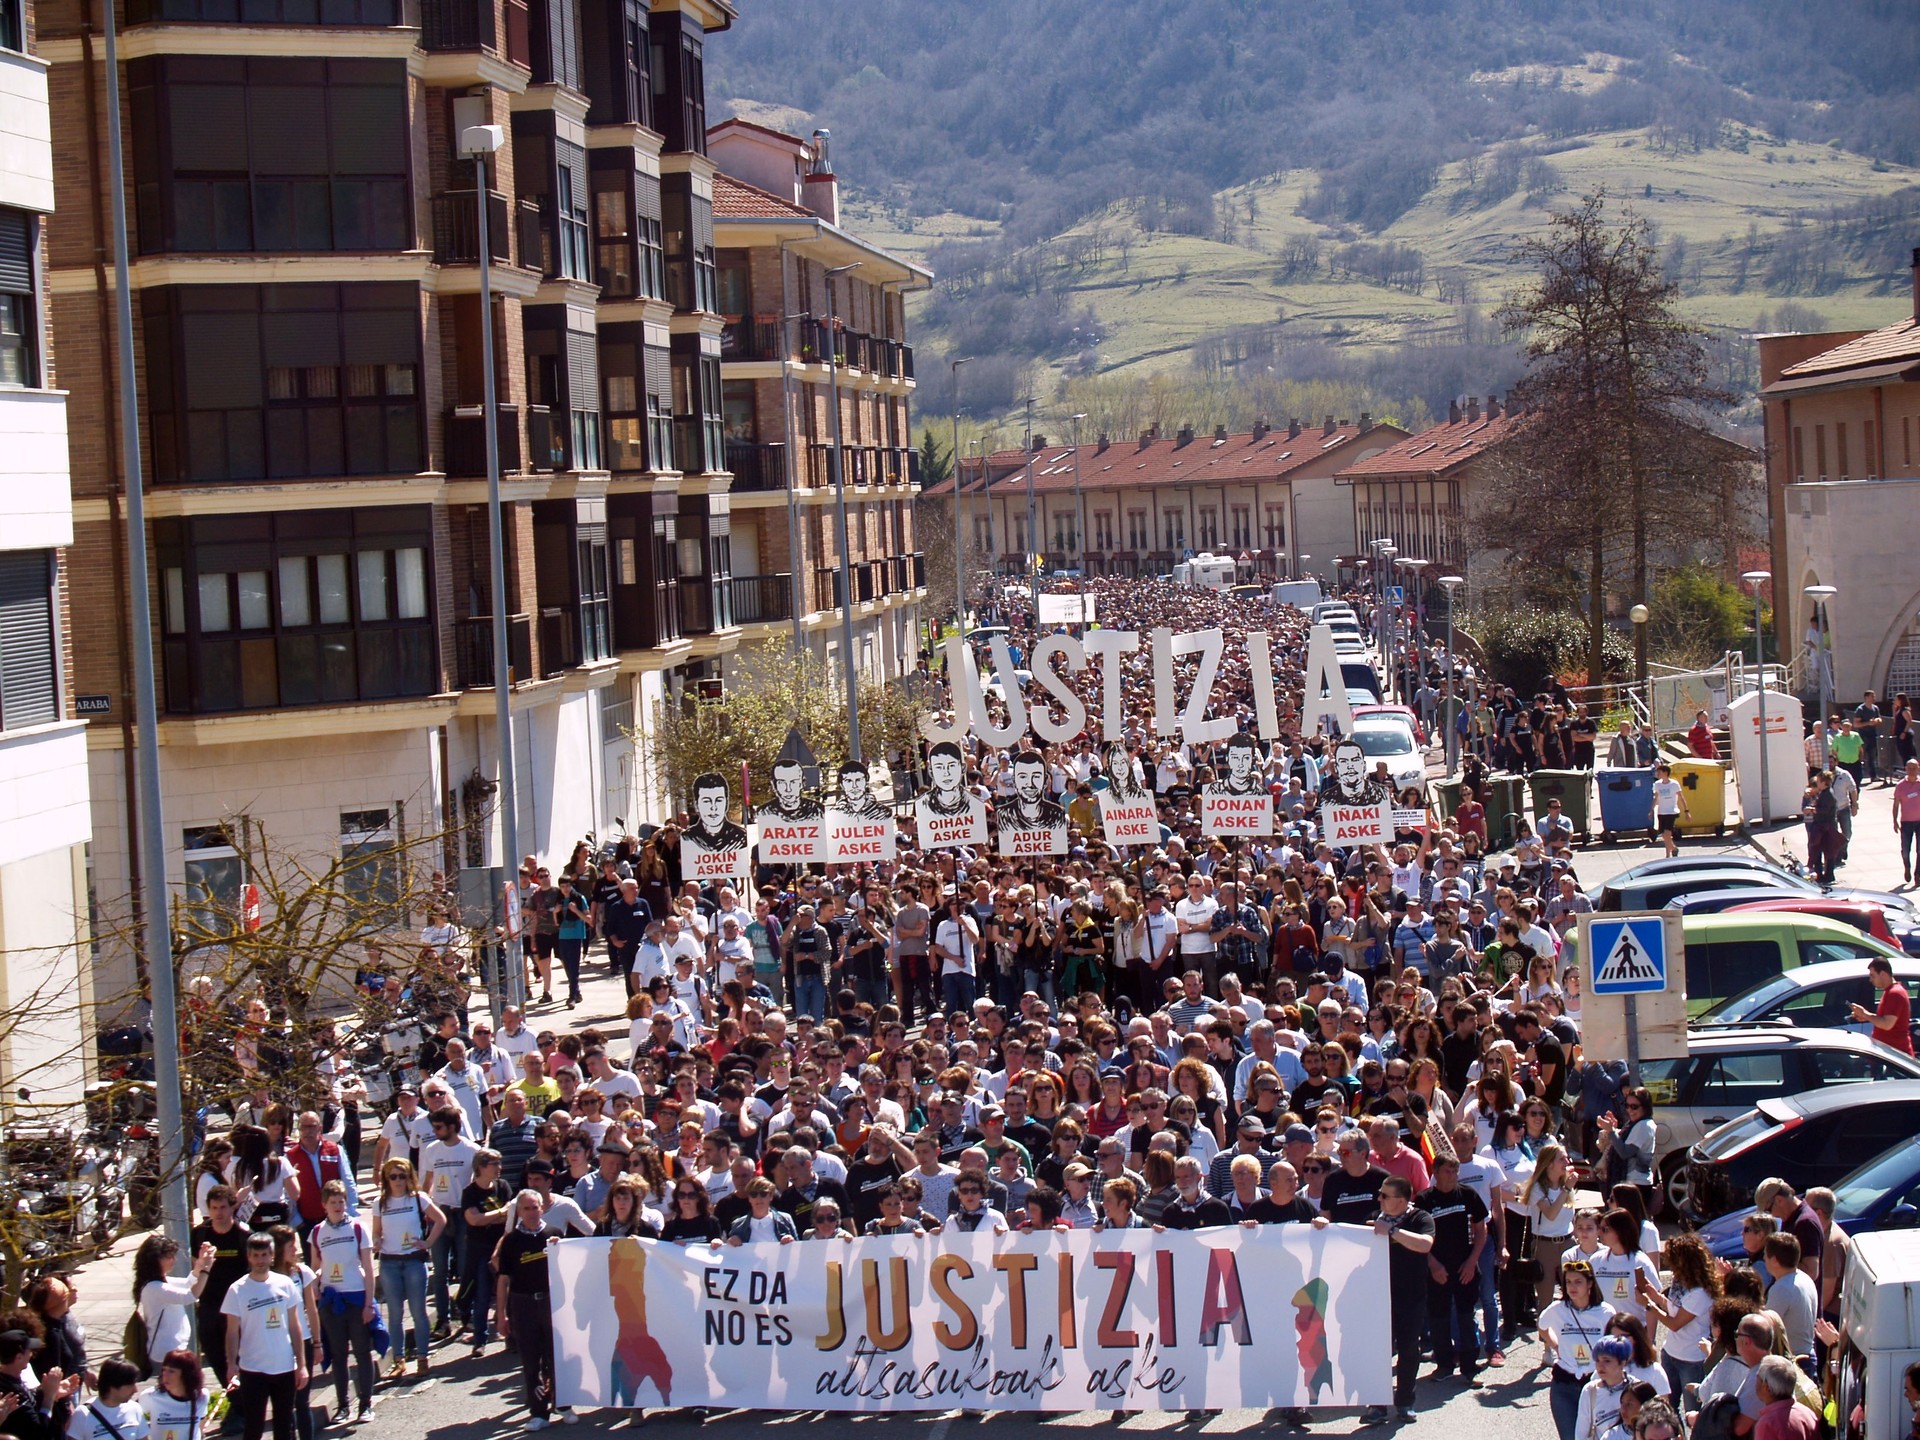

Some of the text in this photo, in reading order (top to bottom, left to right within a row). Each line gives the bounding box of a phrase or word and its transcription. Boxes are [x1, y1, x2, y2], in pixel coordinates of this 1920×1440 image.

[924, 624, 1355, 748] JUSTIZIA
[76, 699, 109, 710] ARABA
[1206, 799, 1266, 812] JONAN
[1105, 807, 1153, 821] AINARA
[1332, 806, 1381, 823] IÑAKI
[929, 815, 974, 831] OIHAN
[1115, 822, 1149, 837] ASKE
[1213, 815, 1259, 829] ASKE
[763, 825, 819, 840] ARATZ
[831, 825, 885, 841] JULEN
[933, 829, 971, 843] ASKE
[1012, 831, 1052, 842] ADUR
[1336, 823, 1381, 839] ASKE
[769, 843, 814, 856] ASKE
[837, 841, 882, 856] ASKE
[1014, 844, 1051, 853] ASKE
[694, 851, 737, 865] JOKIN
[697, 863, 734, 876] ASKE
[705, 1248, 1253, 1352] EZ DA JUSTIZIA
[705, 1309, 793, 1346] NO ES
[816, 1332, 1186, 1400] altsasukoak aske
